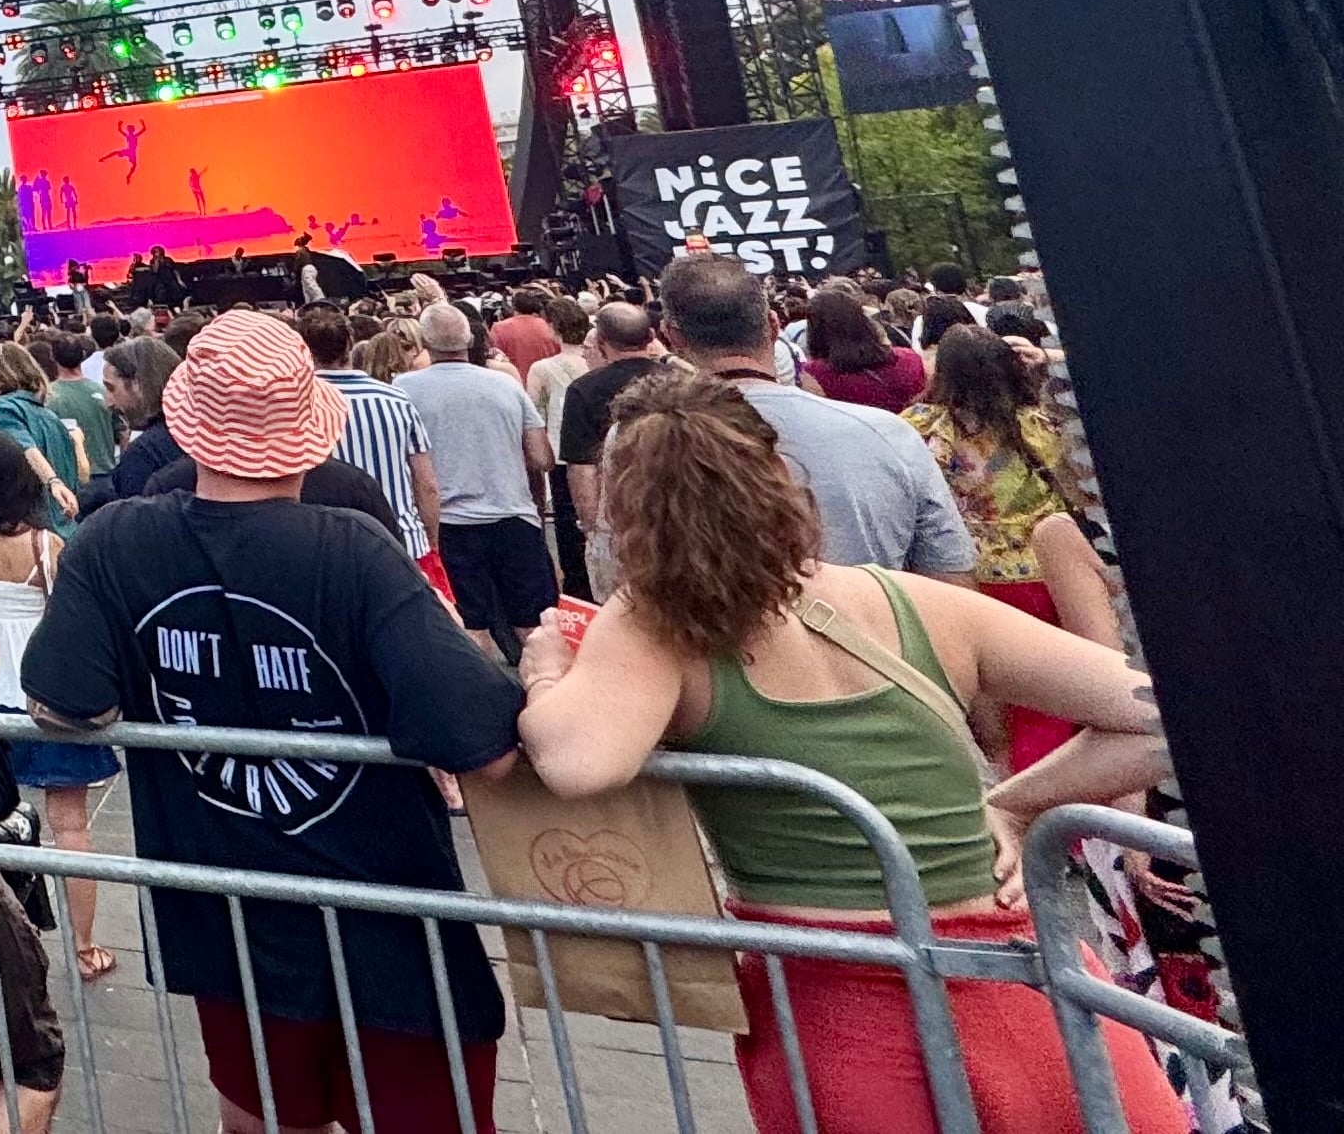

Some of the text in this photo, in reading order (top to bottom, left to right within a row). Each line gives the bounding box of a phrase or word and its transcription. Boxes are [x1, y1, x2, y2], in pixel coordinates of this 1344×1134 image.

[664, 189, 827, 240] JAZZ
[157, 626, 311, 693] DON'T HATE
